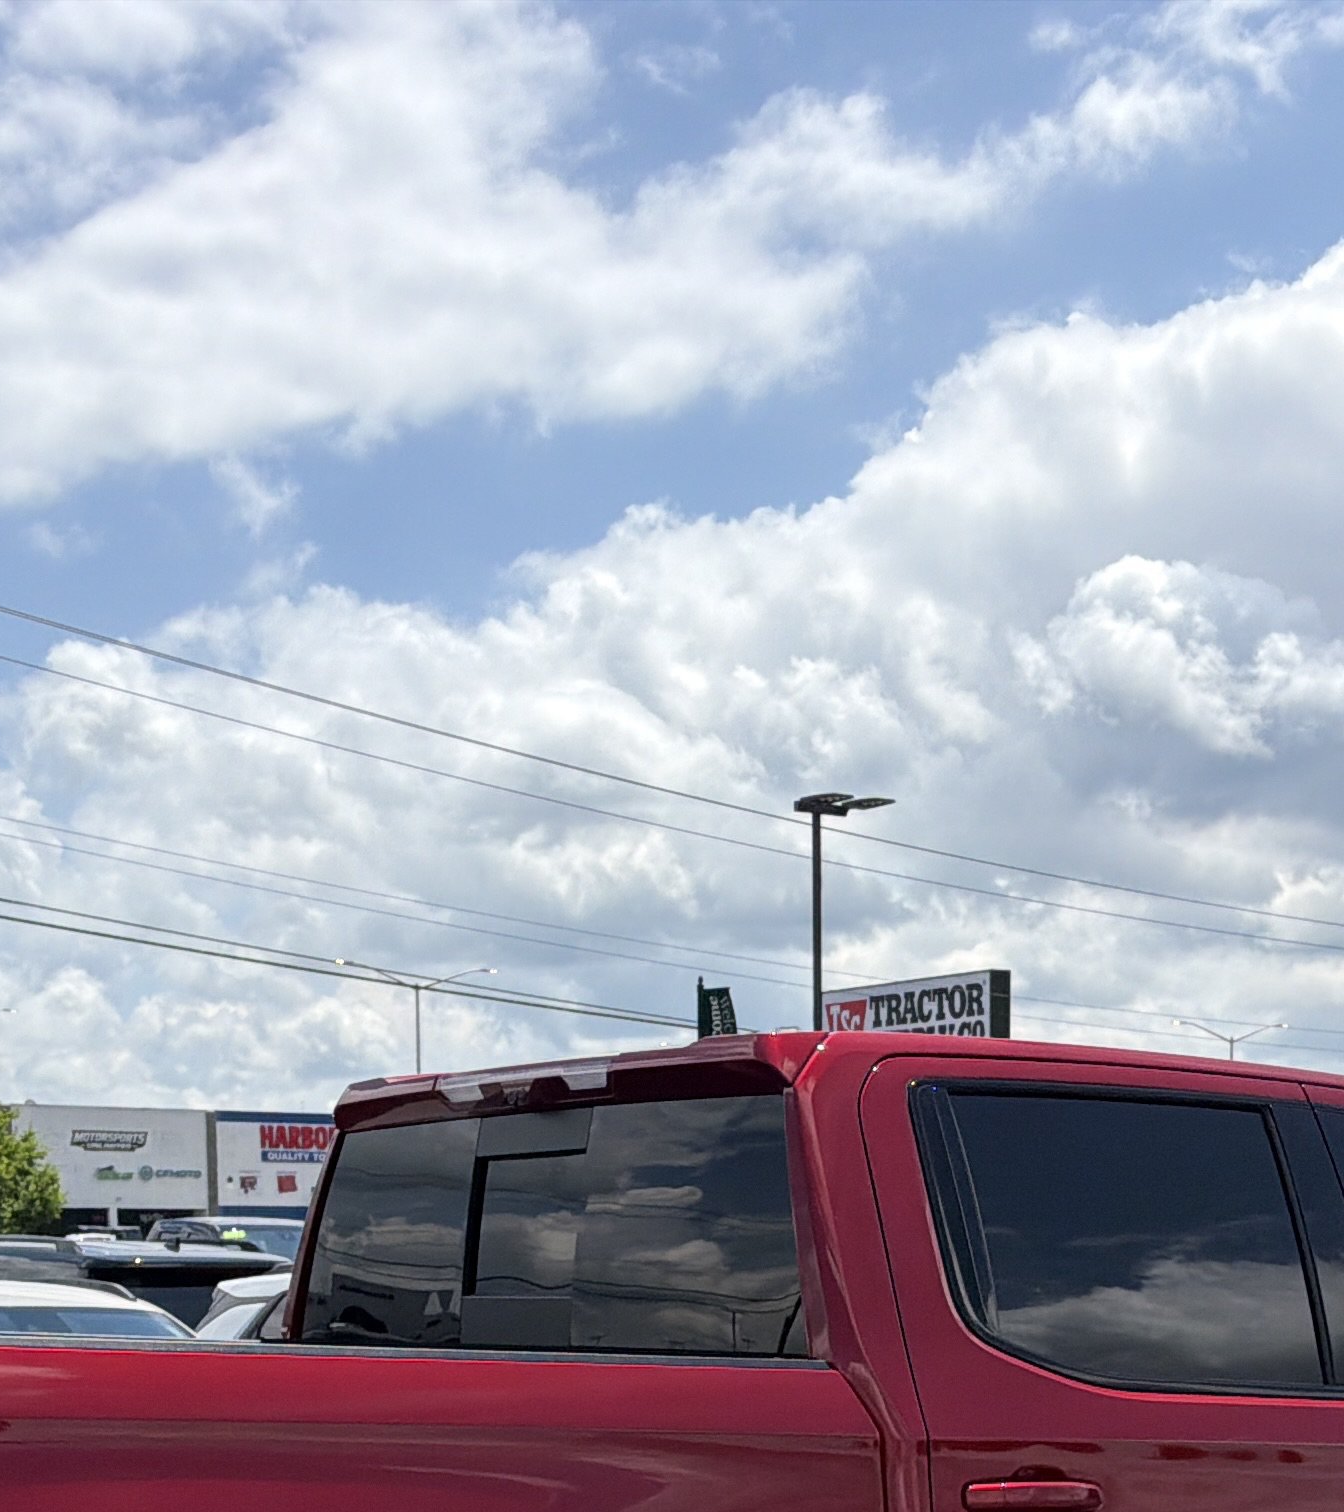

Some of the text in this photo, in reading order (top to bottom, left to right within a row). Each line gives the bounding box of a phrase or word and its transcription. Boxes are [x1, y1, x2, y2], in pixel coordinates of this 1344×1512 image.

[869, 982, 985, 1028] TRACTOR
[71, 1131, 146, 1145] MOTORSPORTS
[267, 1152, 310, 1161] QUALITY
